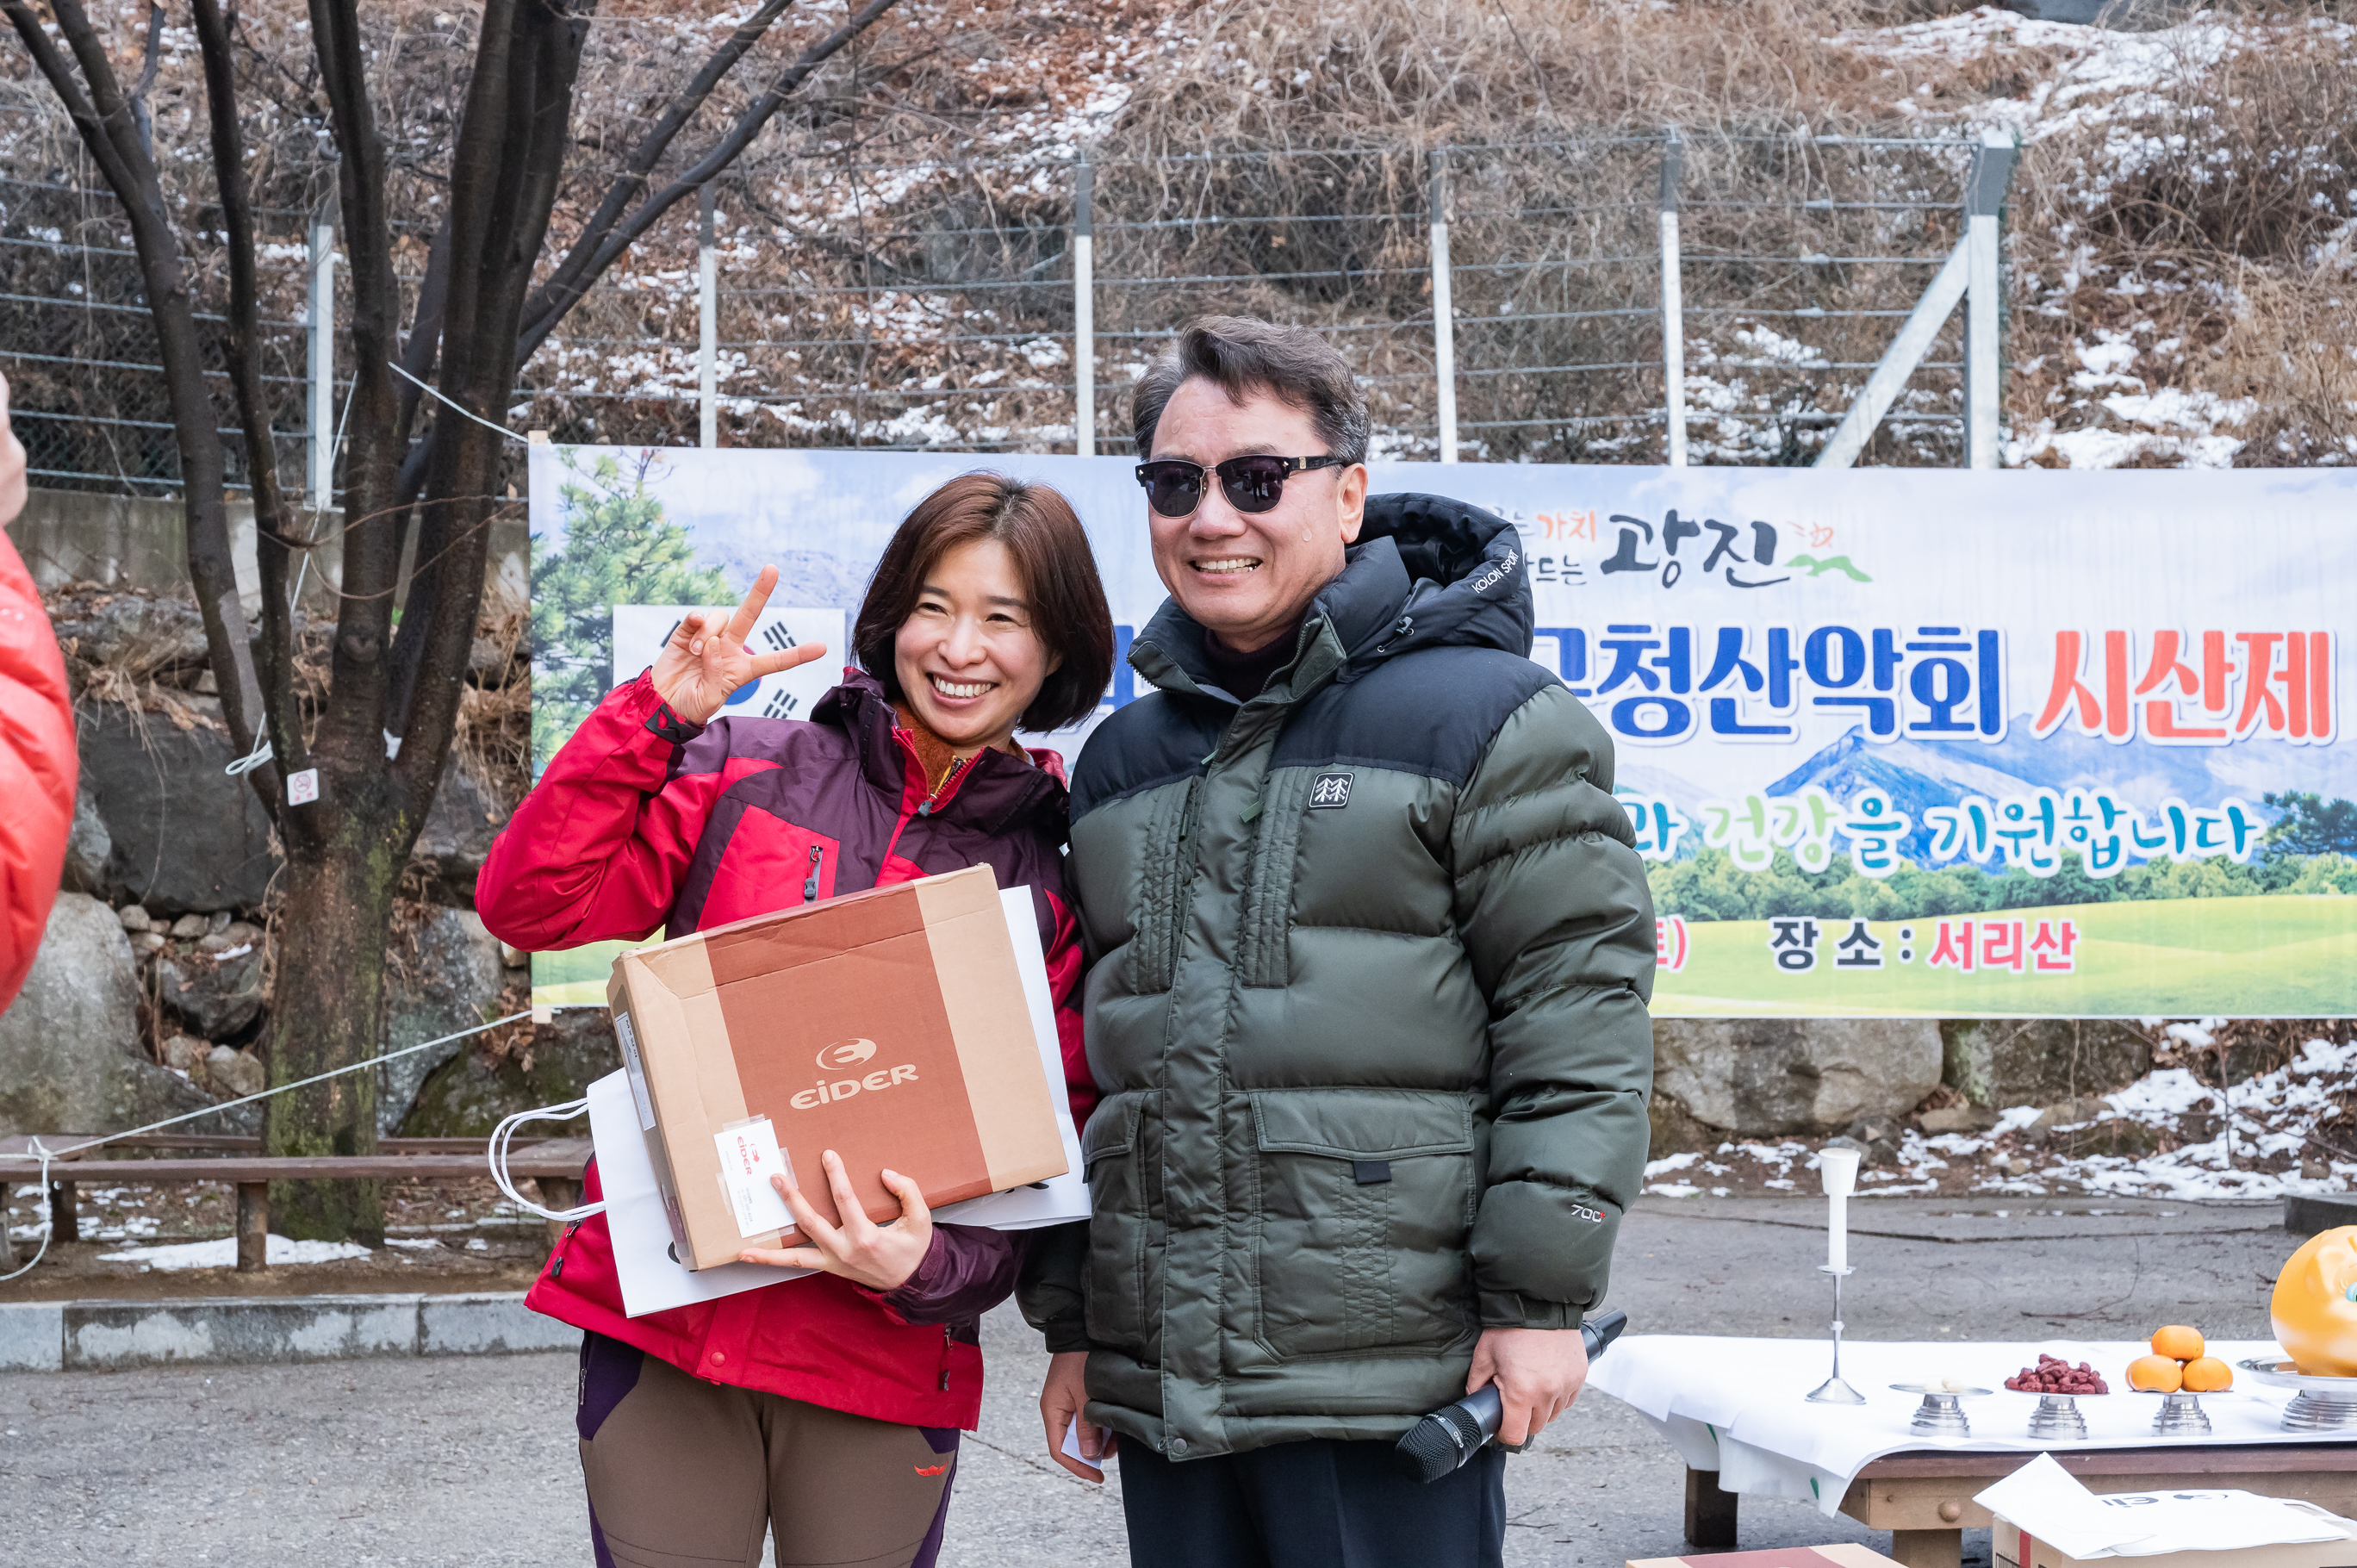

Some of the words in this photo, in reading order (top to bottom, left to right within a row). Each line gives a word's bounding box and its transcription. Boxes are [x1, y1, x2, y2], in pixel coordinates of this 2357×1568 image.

[1537, 510, 1596, 542] 가치
[1600, 509, 1790, 588] 광진
[1471, 568, 1504, 594] KOLON
[1502, 549, 1519, 574] SPORT
[2036, 630, 2330, 737] 시산제
[1705, 794, 1902, 868] 건강을
[1932, 796, 2258, 869] 기원합니다
[1930, 922, 2076, 970] 서리산
